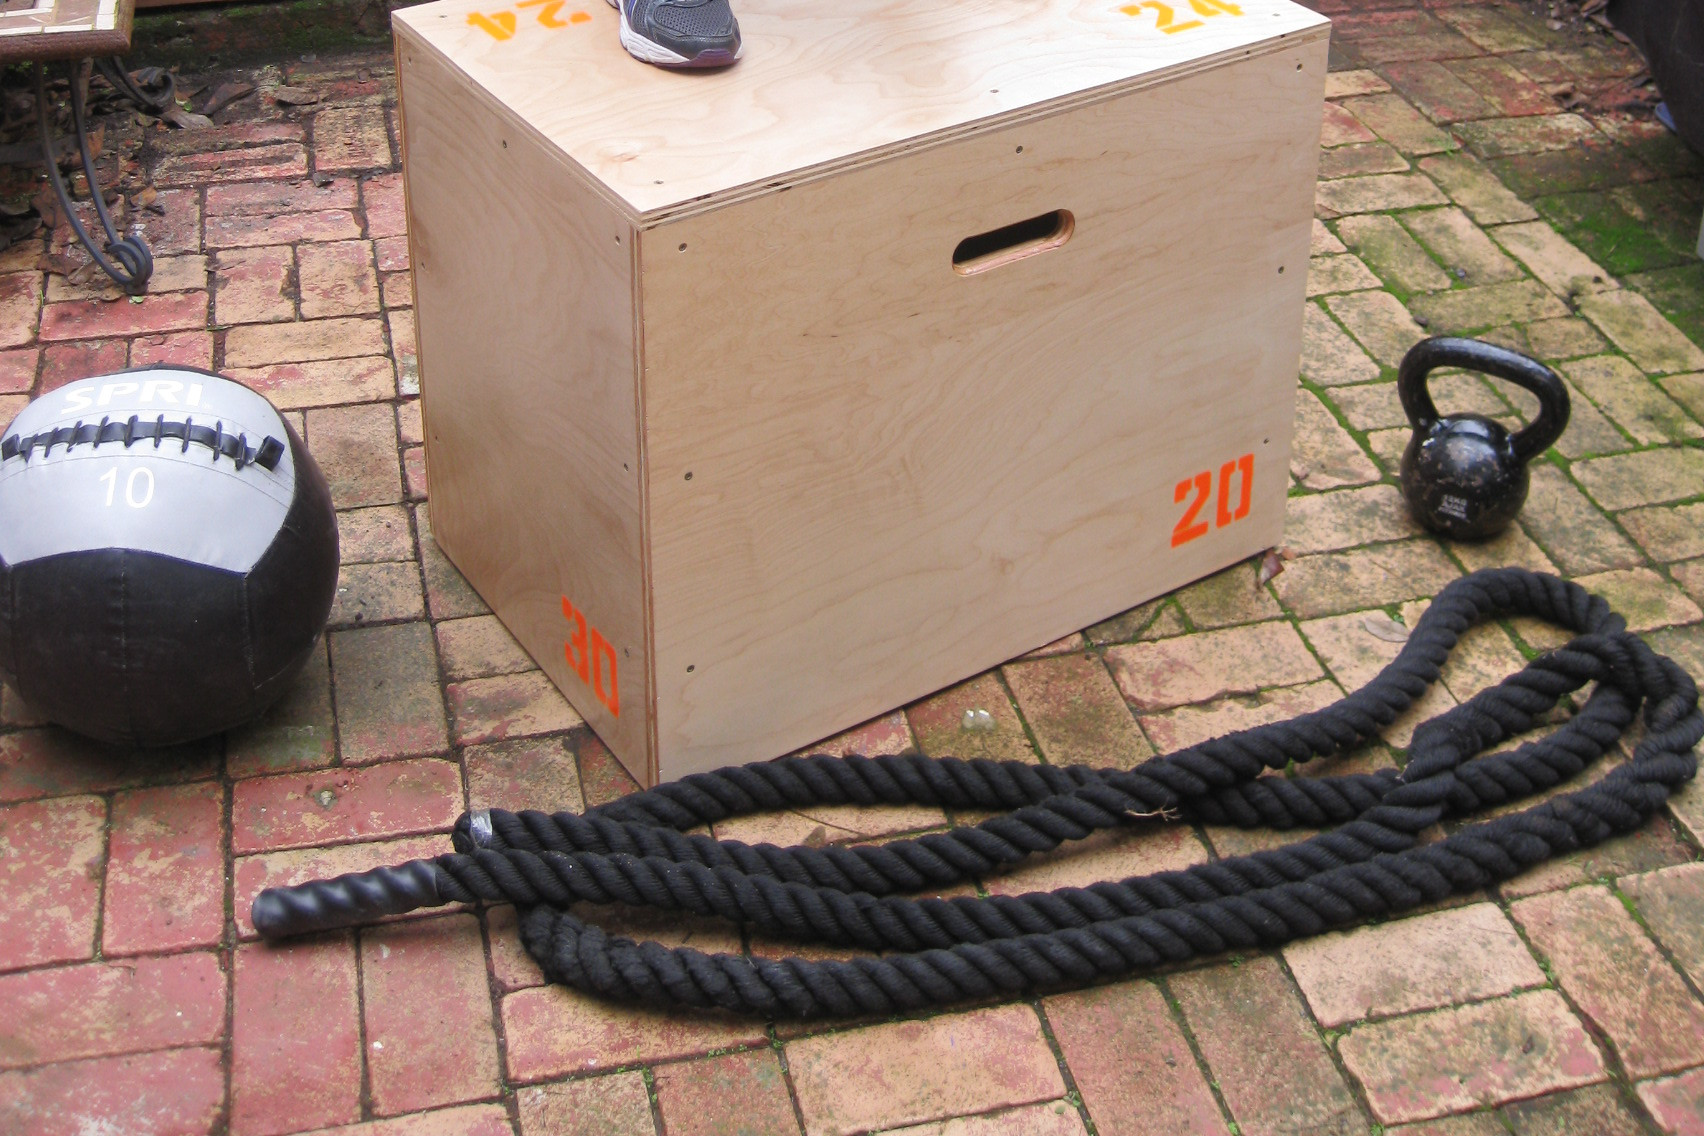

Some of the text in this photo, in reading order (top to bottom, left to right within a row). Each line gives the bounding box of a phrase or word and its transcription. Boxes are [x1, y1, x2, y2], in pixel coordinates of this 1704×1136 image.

[61, 380, 203, 415] SPRI
[100, 466, 155, 509] 10
[1170, 453, 1255, 549] 20
[561, 594, 620, 720] 30
